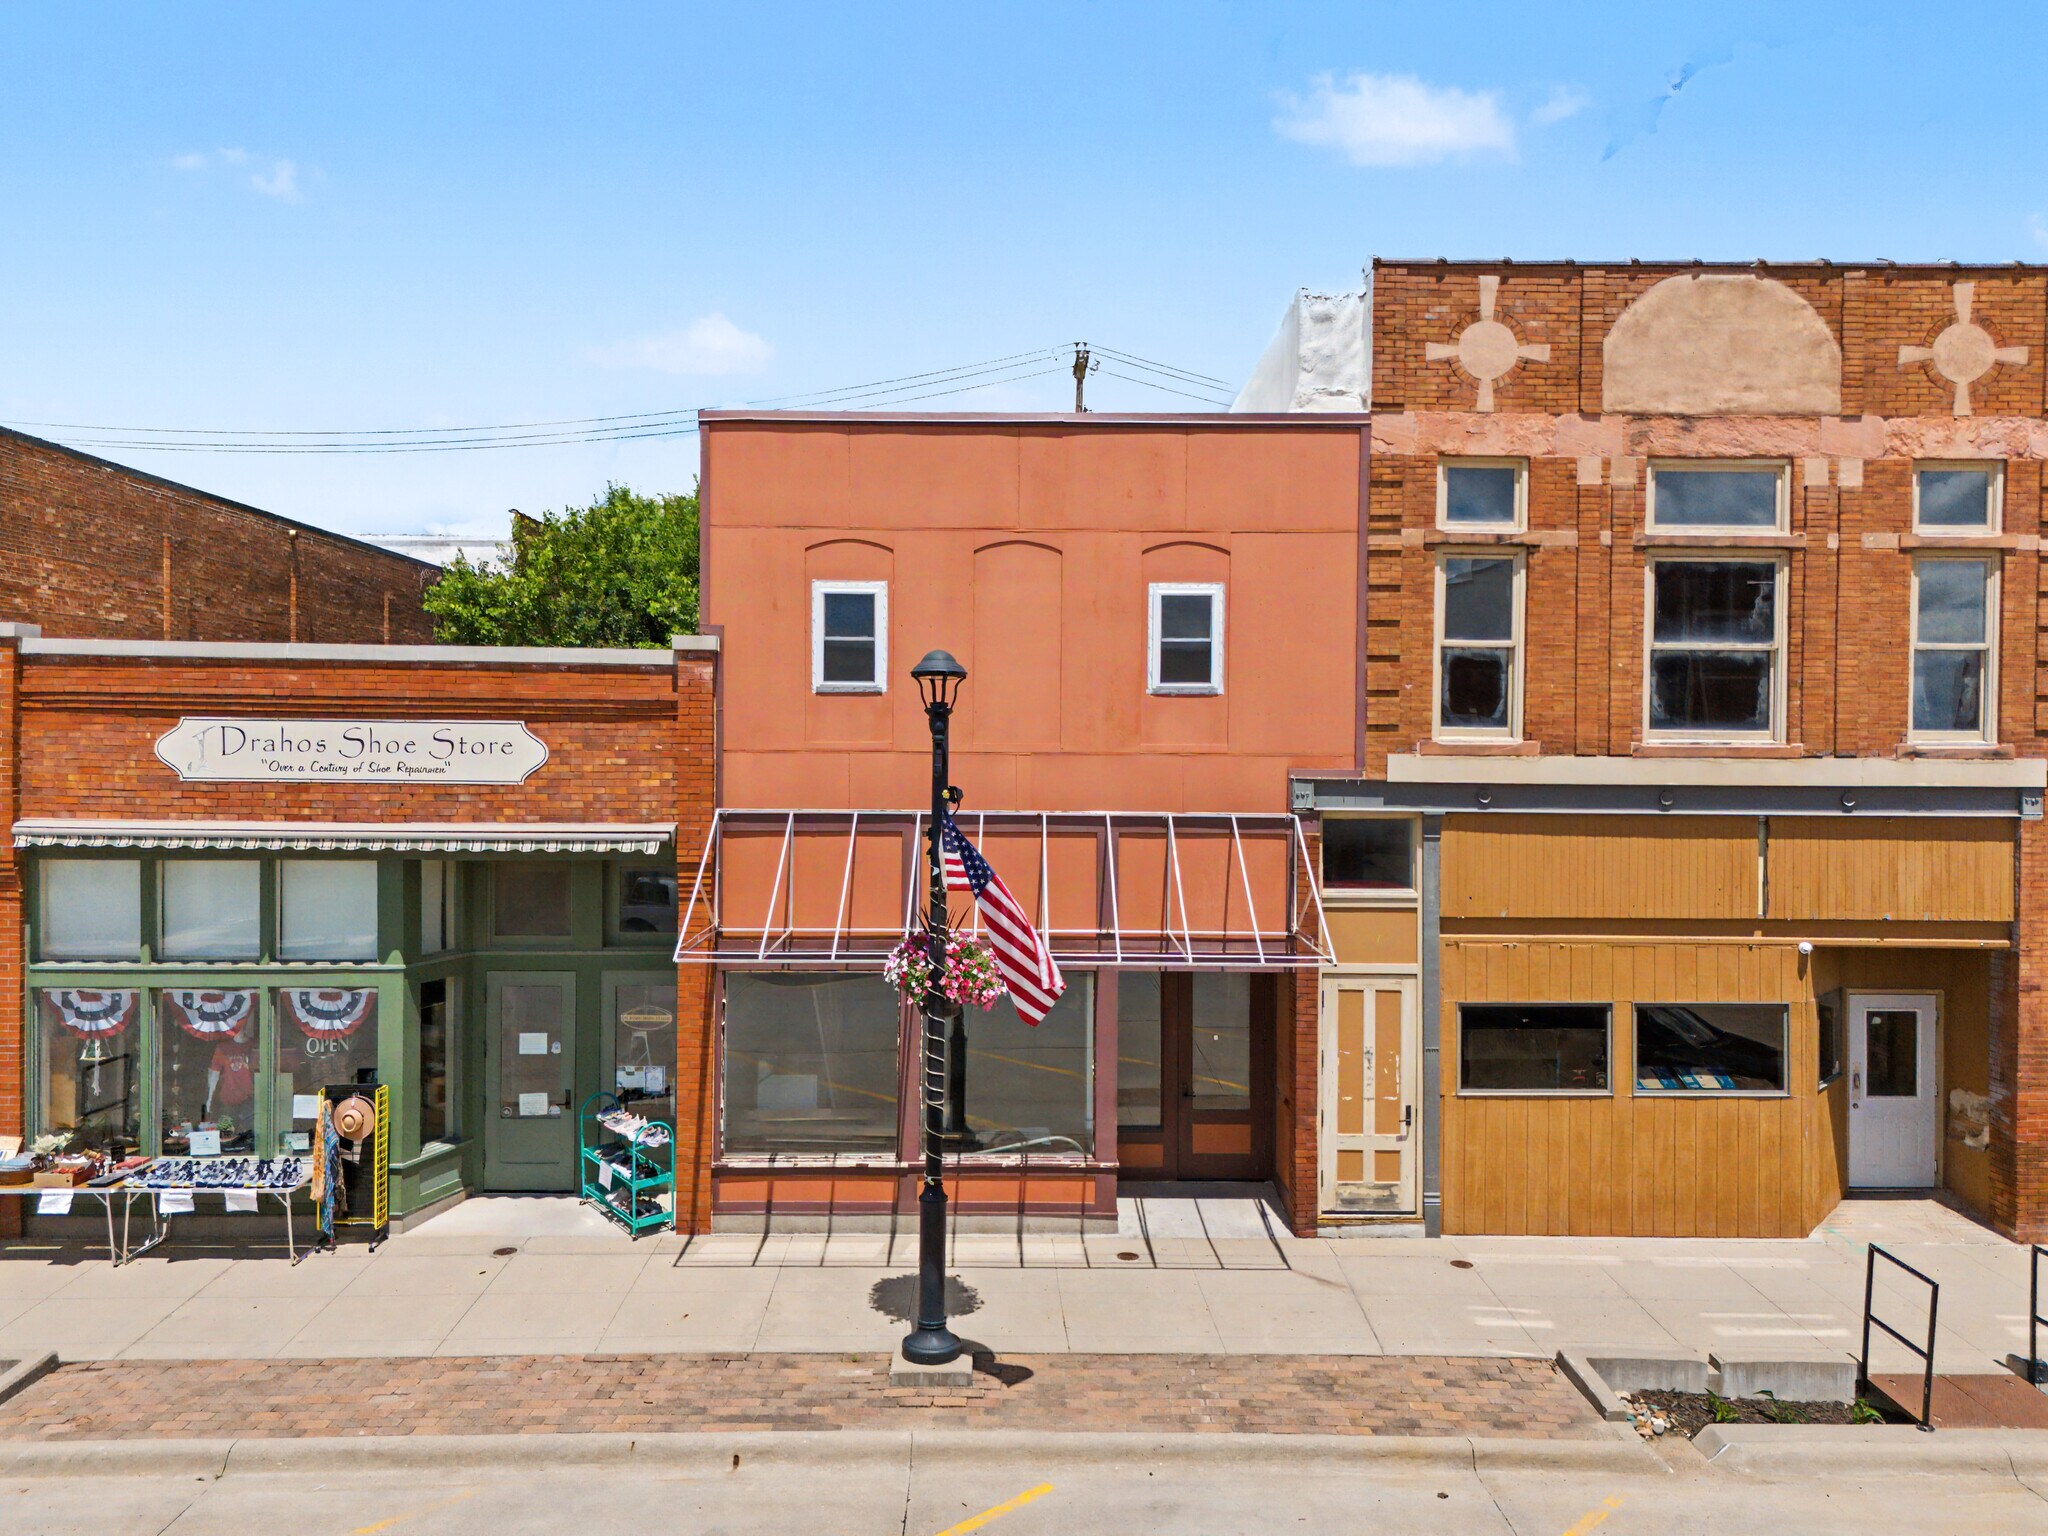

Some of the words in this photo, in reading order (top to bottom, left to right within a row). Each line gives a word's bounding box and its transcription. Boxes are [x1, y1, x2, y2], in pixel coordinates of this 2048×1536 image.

[221, 726, 327, 756] Drahos
[338, 727, 417, 758] Shoe
[428, 728, 514, 760] Store
[297, 764, 306, 773] a
[310, 760, 348, 776] Century
[353, 761, 365, 773] of
[367, 761, 392, 774] Shoe
[306, 1037, 349, 1054] OPEN
